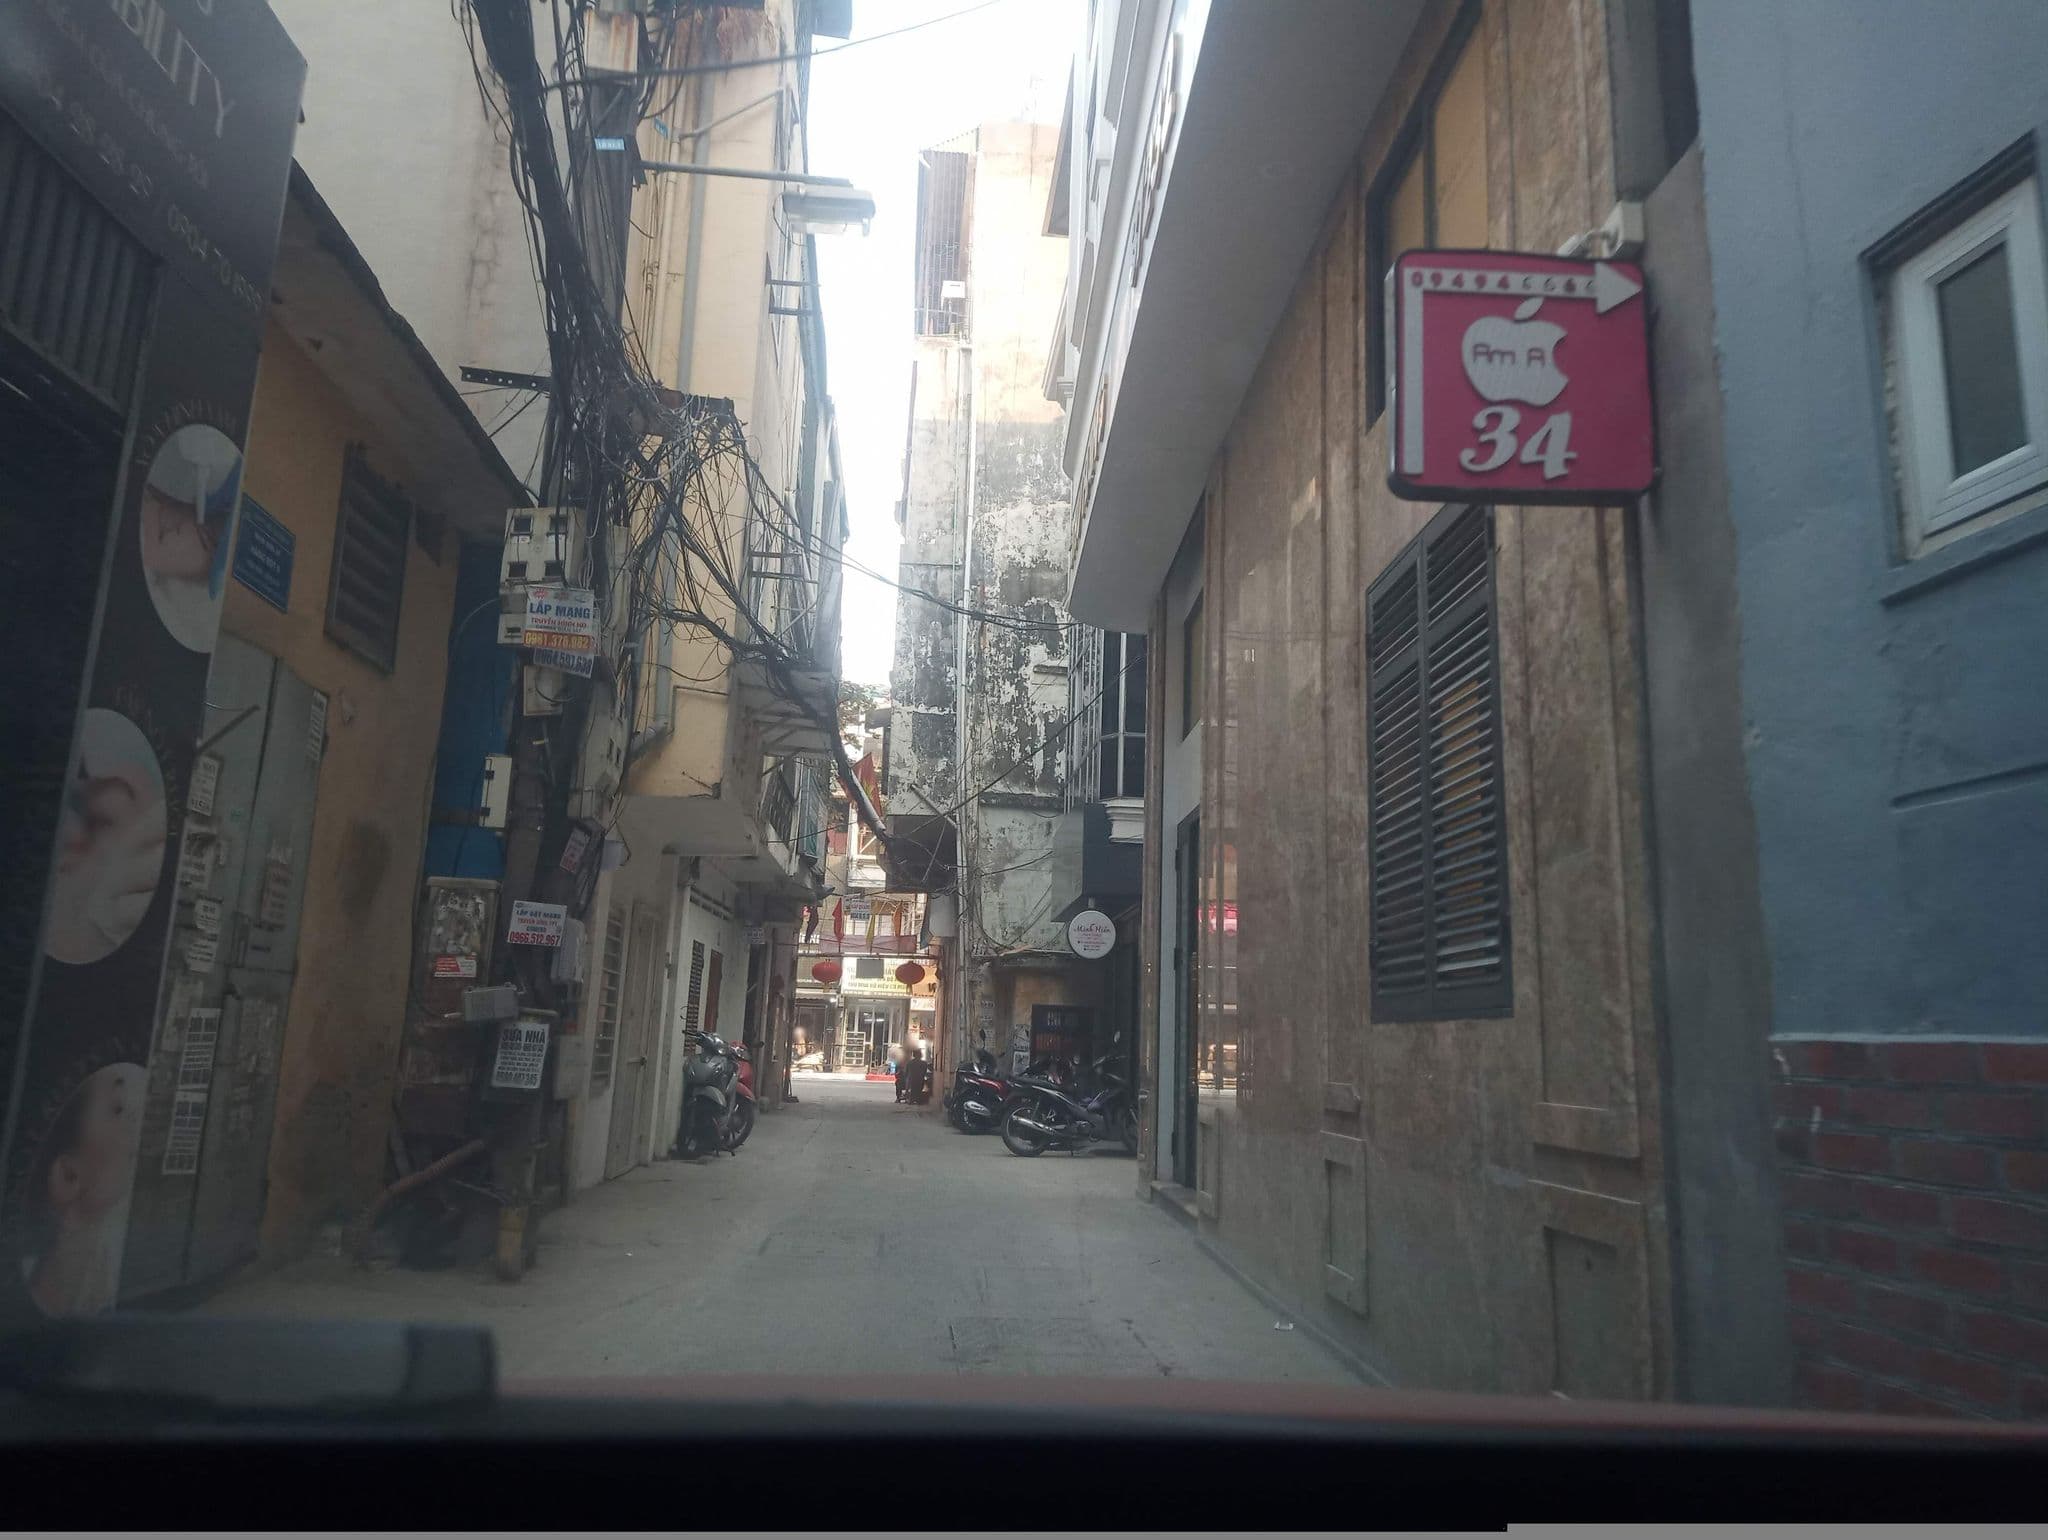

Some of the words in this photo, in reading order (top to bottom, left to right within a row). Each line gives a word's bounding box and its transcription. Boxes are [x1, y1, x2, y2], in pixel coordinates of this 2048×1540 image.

[1459, 405, 1578, 480] 34
[555, 605, 590, 620] MẠNG
[525, 1028, 546, 1043] NHÀ
